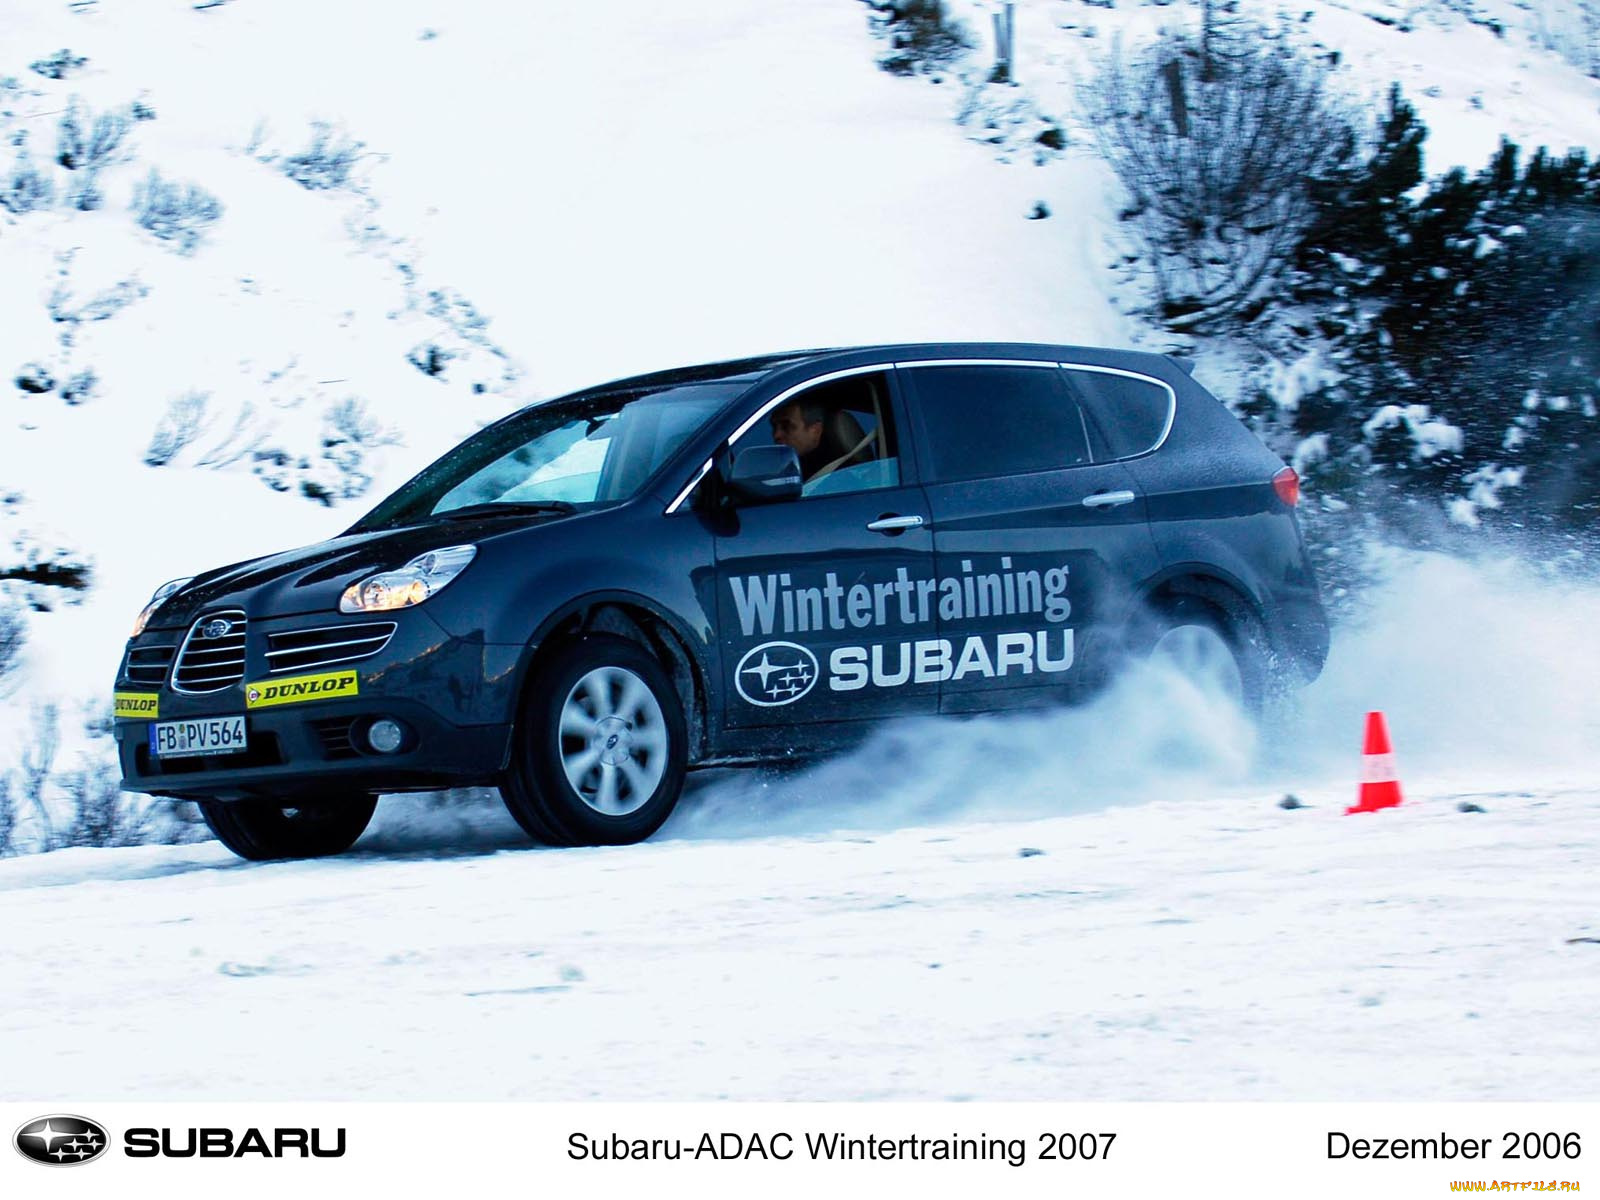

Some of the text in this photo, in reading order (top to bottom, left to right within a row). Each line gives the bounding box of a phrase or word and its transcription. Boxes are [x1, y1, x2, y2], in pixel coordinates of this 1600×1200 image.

[729, 556, 1071, 636] Wintertraining
[263, 677, 354, 700] DUNLOP
[829, 628, 1075, 692] SUBARU
